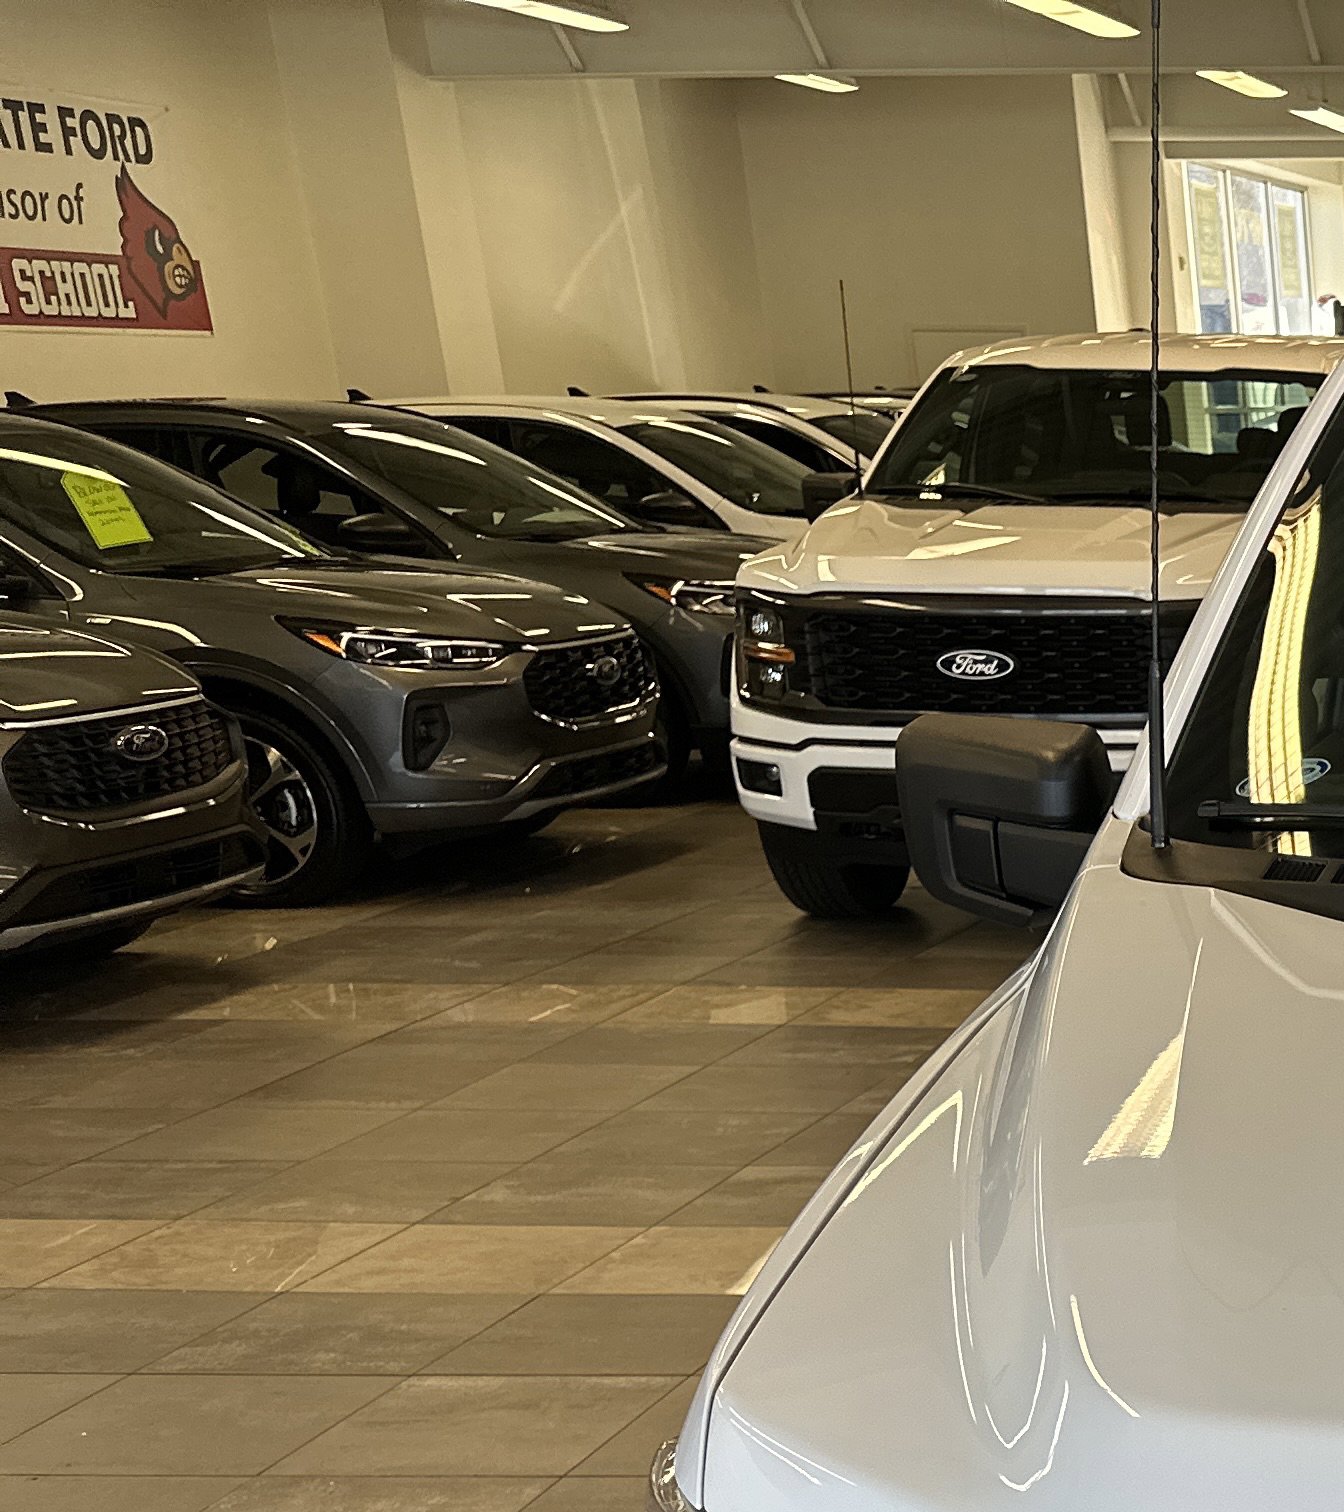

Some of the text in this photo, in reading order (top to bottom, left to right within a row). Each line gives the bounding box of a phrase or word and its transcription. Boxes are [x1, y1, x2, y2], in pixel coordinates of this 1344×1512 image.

[57, 105, 153, 165] FORD
[57, 182, 84, 225] of
[12, 258, 137, 318] SCHOOL
[951, 653, 999, 675] Ford
